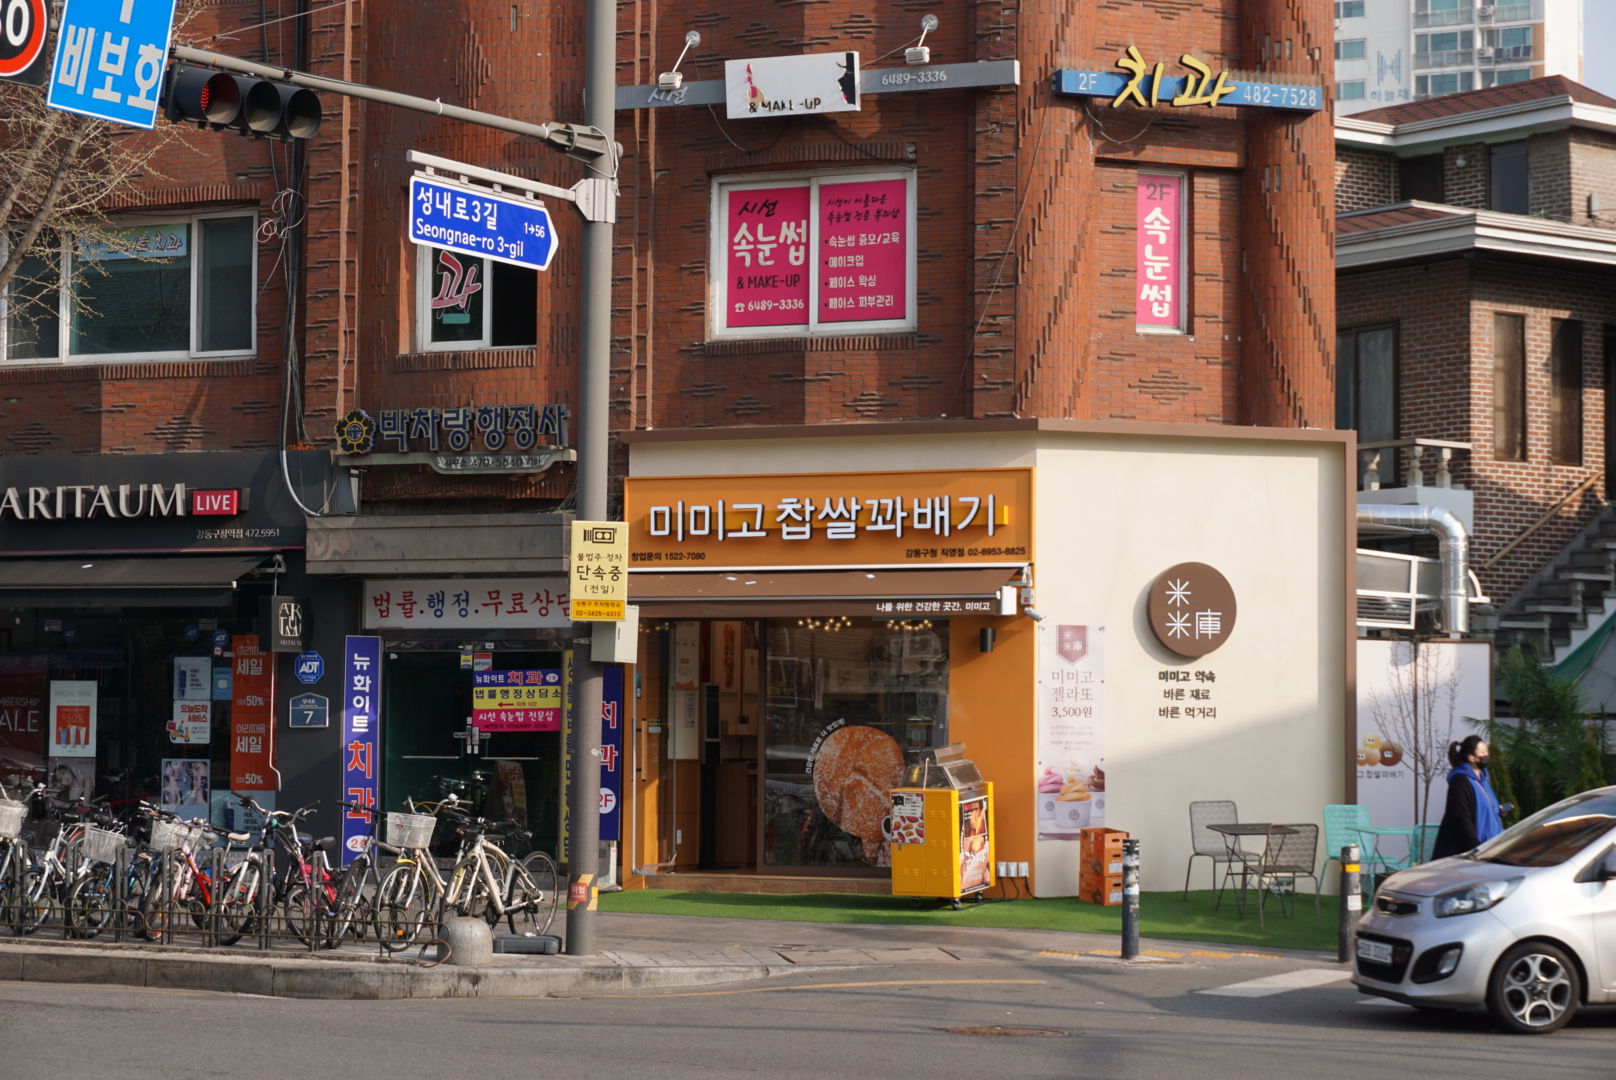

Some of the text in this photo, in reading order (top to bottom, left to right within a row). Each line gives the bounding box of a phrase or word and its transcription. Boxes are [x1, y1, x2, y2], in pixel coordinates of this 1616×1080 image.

[0, 0, 29, 46] 0
[58, 24, 163, 111] 비보호
[881, 70, 947, 87] 6489-3336
[1079, 45, 1317, 108] 2F 치과 482-7528
[1370, 88, 1409, 102] 하늘채
[748, 101, 758, 113] &
[1145, 183, 1171, 200] 2F
[855, 194, 887, 208] 아름다운
[417, 187, 497, 230] 성내로3길
[738, 199, 778, 218] 시선
[855, 210, 870, 221] 전문
[416, 218, 524, 258] Seongnae-ro 3-gil
[733, 220, 807, 268] 속눈썹
[829, 235, 855, 248] 속눈썹
[829, 255, 864, 268] 메이크업
[1140, 207, 1172, 318] 속눈썹
[737, 274, 800, 289] & MAKE-UP
[829, 275, 876, 288] 페이스 왁싱
[748, 299, 804, 311] 6489-3336
[829, 297, 855, 309] 페이스
[0, 483, 230, 519] ARITAUM LIVE
[650, 493, 994, 541] 미미고 찹쌀꽈배기
[632, 552, 705, 561] 창업문의 1522-7080
[905, 547, 1026, 558] 강동구청 직영점 02-6953-8825
[577, 565, 622, 581] 단속중
[876, 602, 893, 612] 나를
[896, 602, 913, 612] 위한
[915, 602, 940, 612] 건강한
[965, 602, 990, 611] 미미고
[237, 658, 262, 675] 세일
[299, 662, 319, 673] ADT
[476, 674, 504, 684] 뉴화이트
[507, 671, 543, 685] 치과
[1052, 669, 1093, 685] 미미고
[1158, 670, 1216, 683] 미미고 약속
[352, 653, 371, 732] 뉴화이트
[1052, 686, 1093, 702] 젤라또
[1164, 688, 1211, 700] 바른 재료
[181, 705, 208, 713] 오늘도착
[1052, 706, 1092, 718] 3,500원
[1158, 706, 1217, 719] 바른 먹거리
[188, 714, 208, 722] 서비스
[304, 711, 313, 724] 7
[479, 711, 554, 722] 시선 속눈썹 전문샵
[235, 736, 262, 753] 세일
[347, 740, 375, 823] 치과
